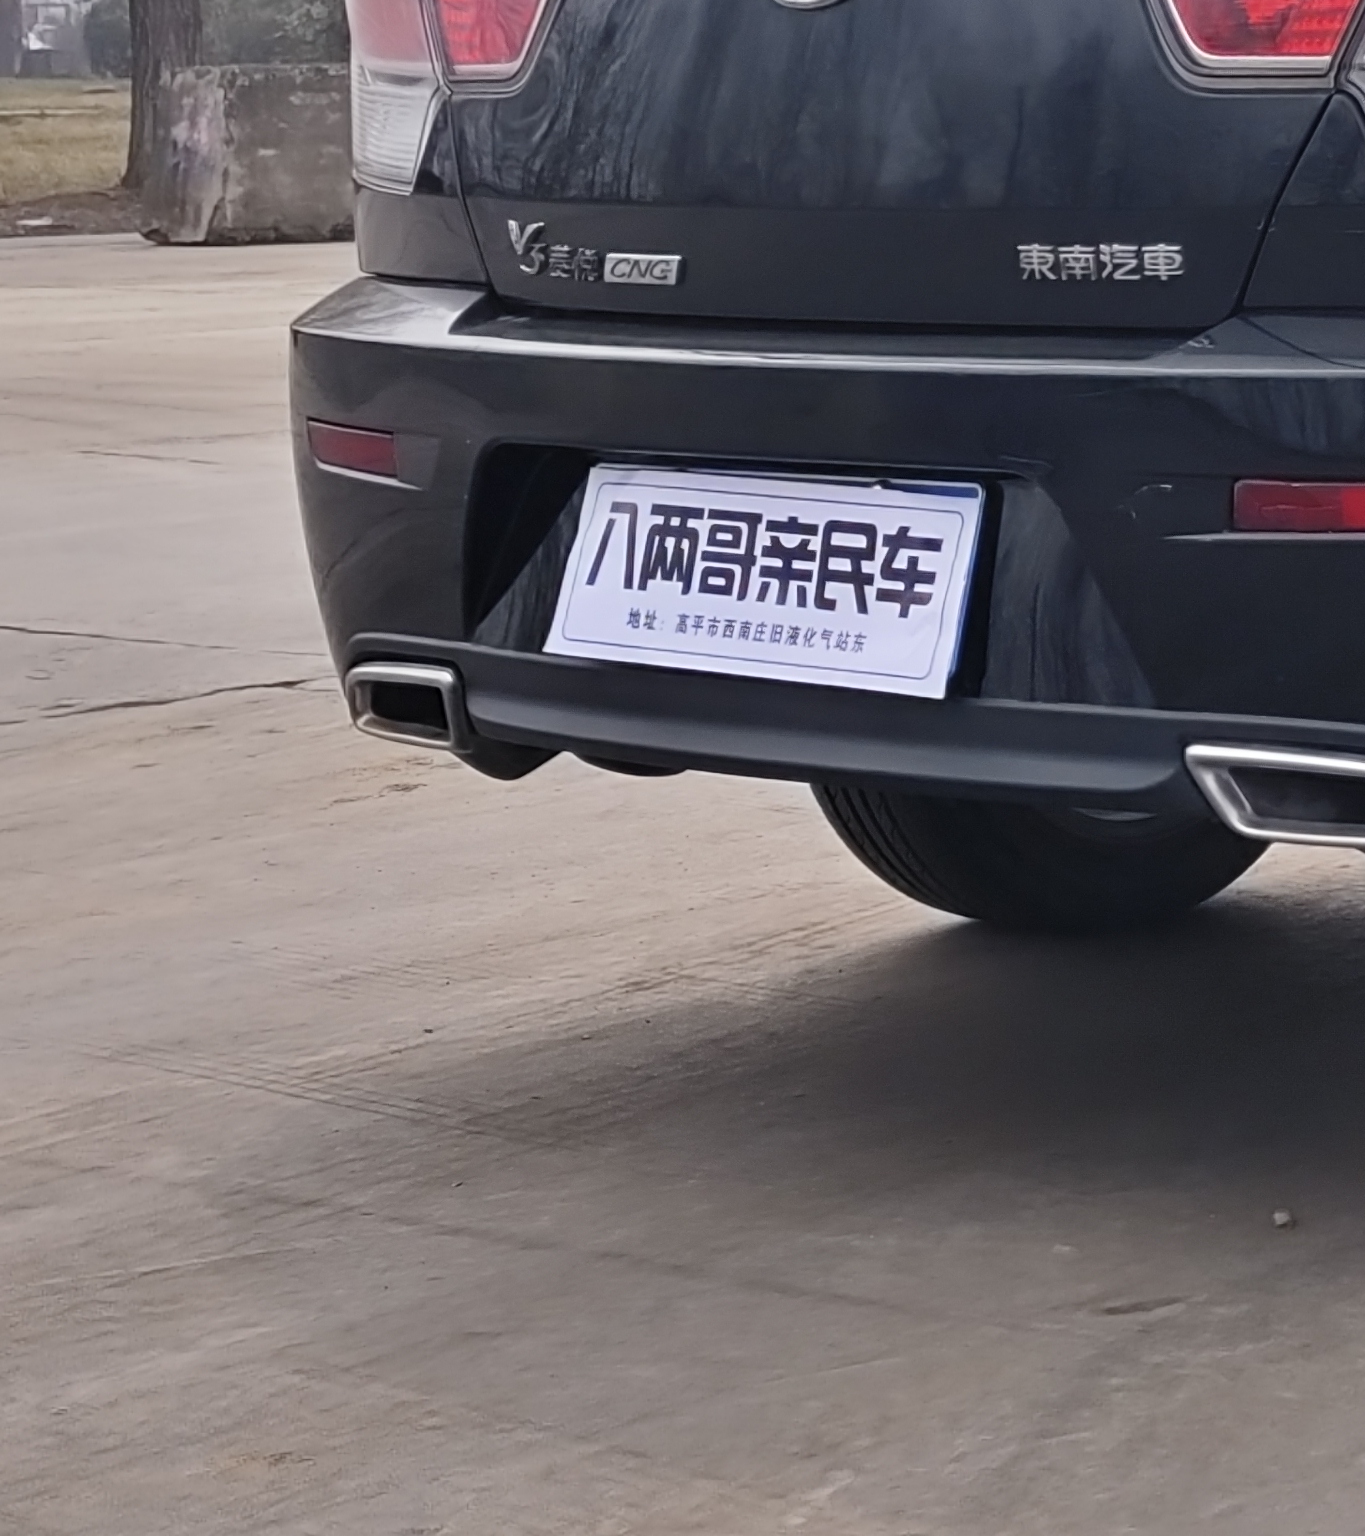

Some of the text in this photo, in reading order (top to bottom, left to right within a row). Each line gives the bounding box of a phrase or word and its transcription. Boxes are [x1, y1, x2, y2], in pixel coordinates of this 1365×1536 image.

[610, 258, 673, 280] CNG
[1016, 243, 1185, 281] 東南汽車
[585, 500, 944, 618] 八两哥亲民车
